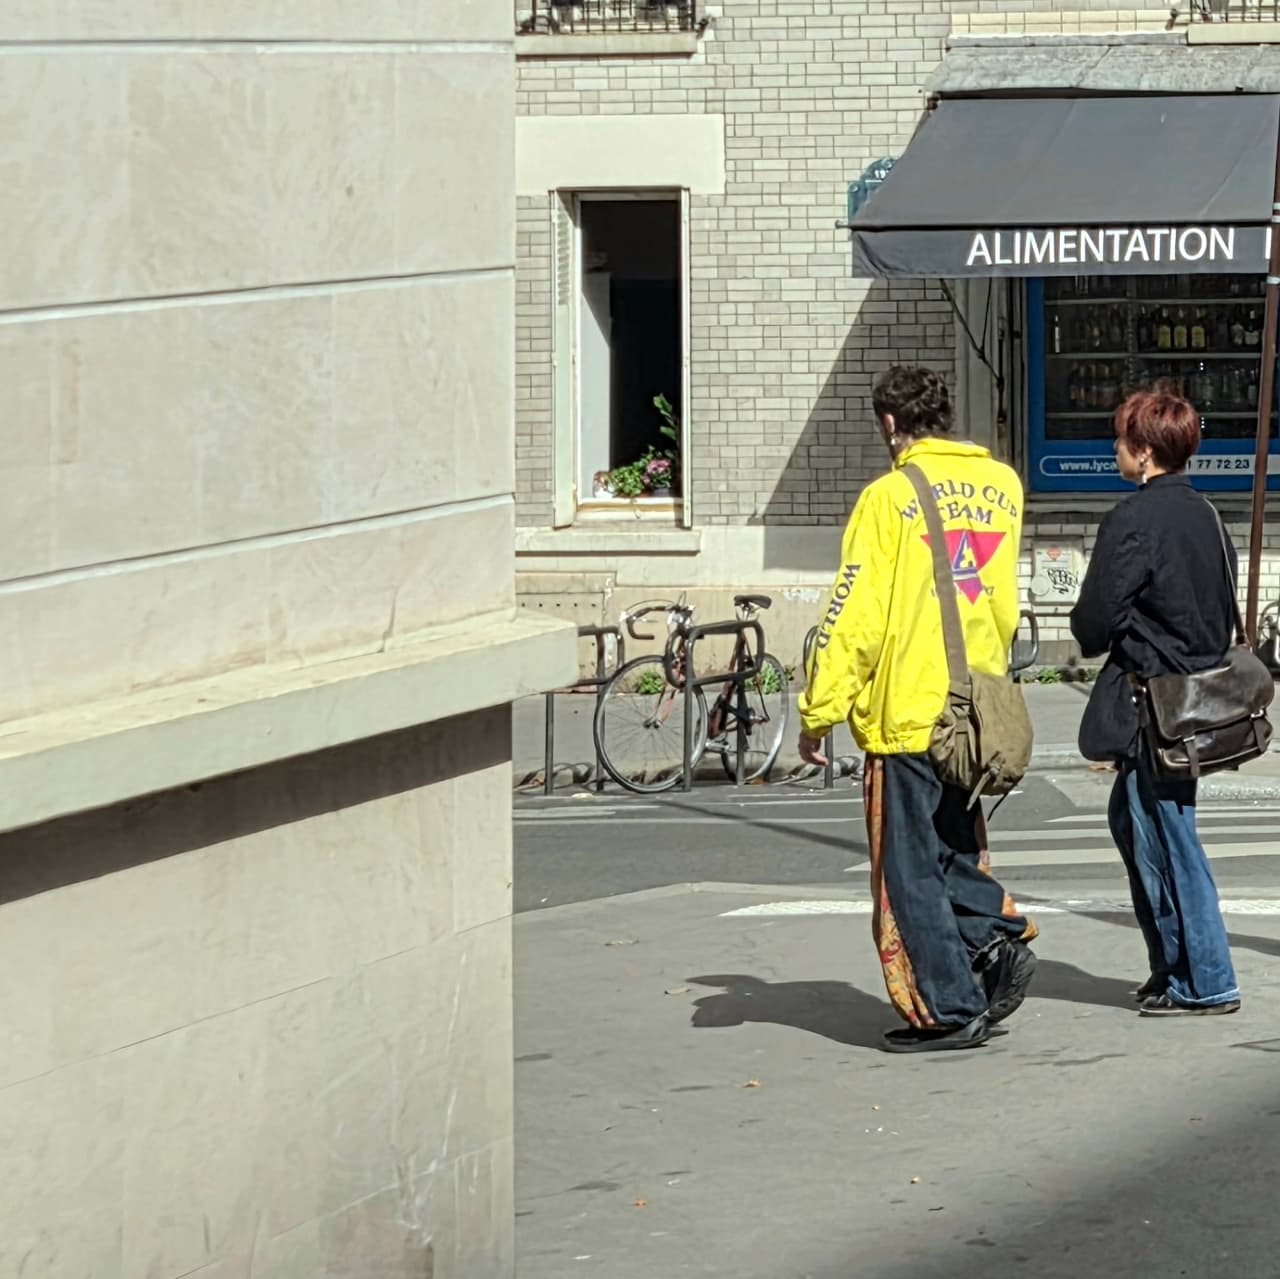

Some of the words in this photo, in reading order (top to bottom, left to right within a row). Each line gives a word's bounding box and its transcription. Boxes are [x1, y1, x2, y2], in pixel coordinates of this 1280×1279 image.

[966, 226, 1234, 266] ALIMENTATION
[1197, 459, 1212, 469] 77
[1216, 459, 1231, 469] 72
[903, 479, 975, 520] WRLD
[982, 485, 1018, 518] CUP
[816, 564, 861, 649] WORLD
